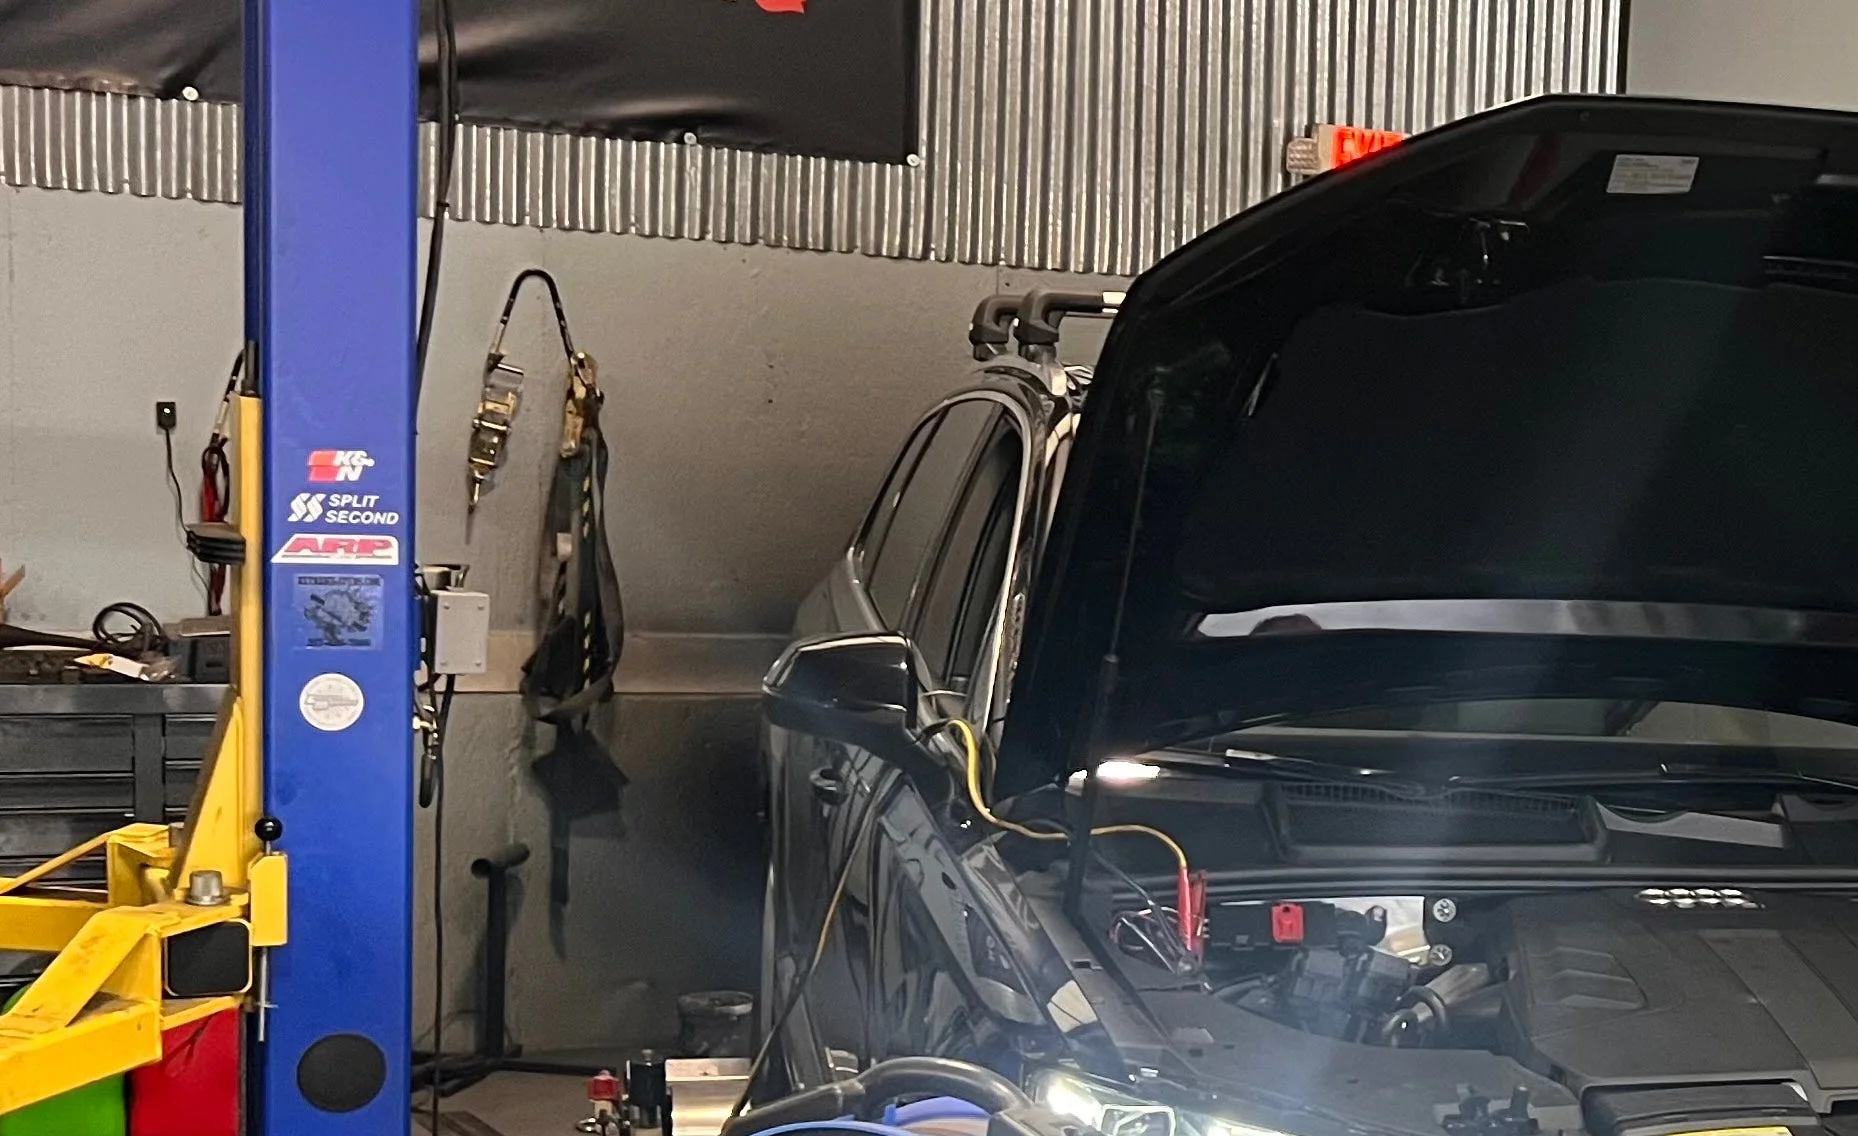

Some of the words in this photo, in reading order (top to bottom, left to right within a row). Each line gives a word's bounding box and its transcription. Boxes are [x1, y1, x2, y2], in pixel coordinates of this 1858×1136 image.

[328, 494, 380, 508] SPLIT
[325, 510, 399, 525] SECOND
[283, 538, 393, 554] ARP
